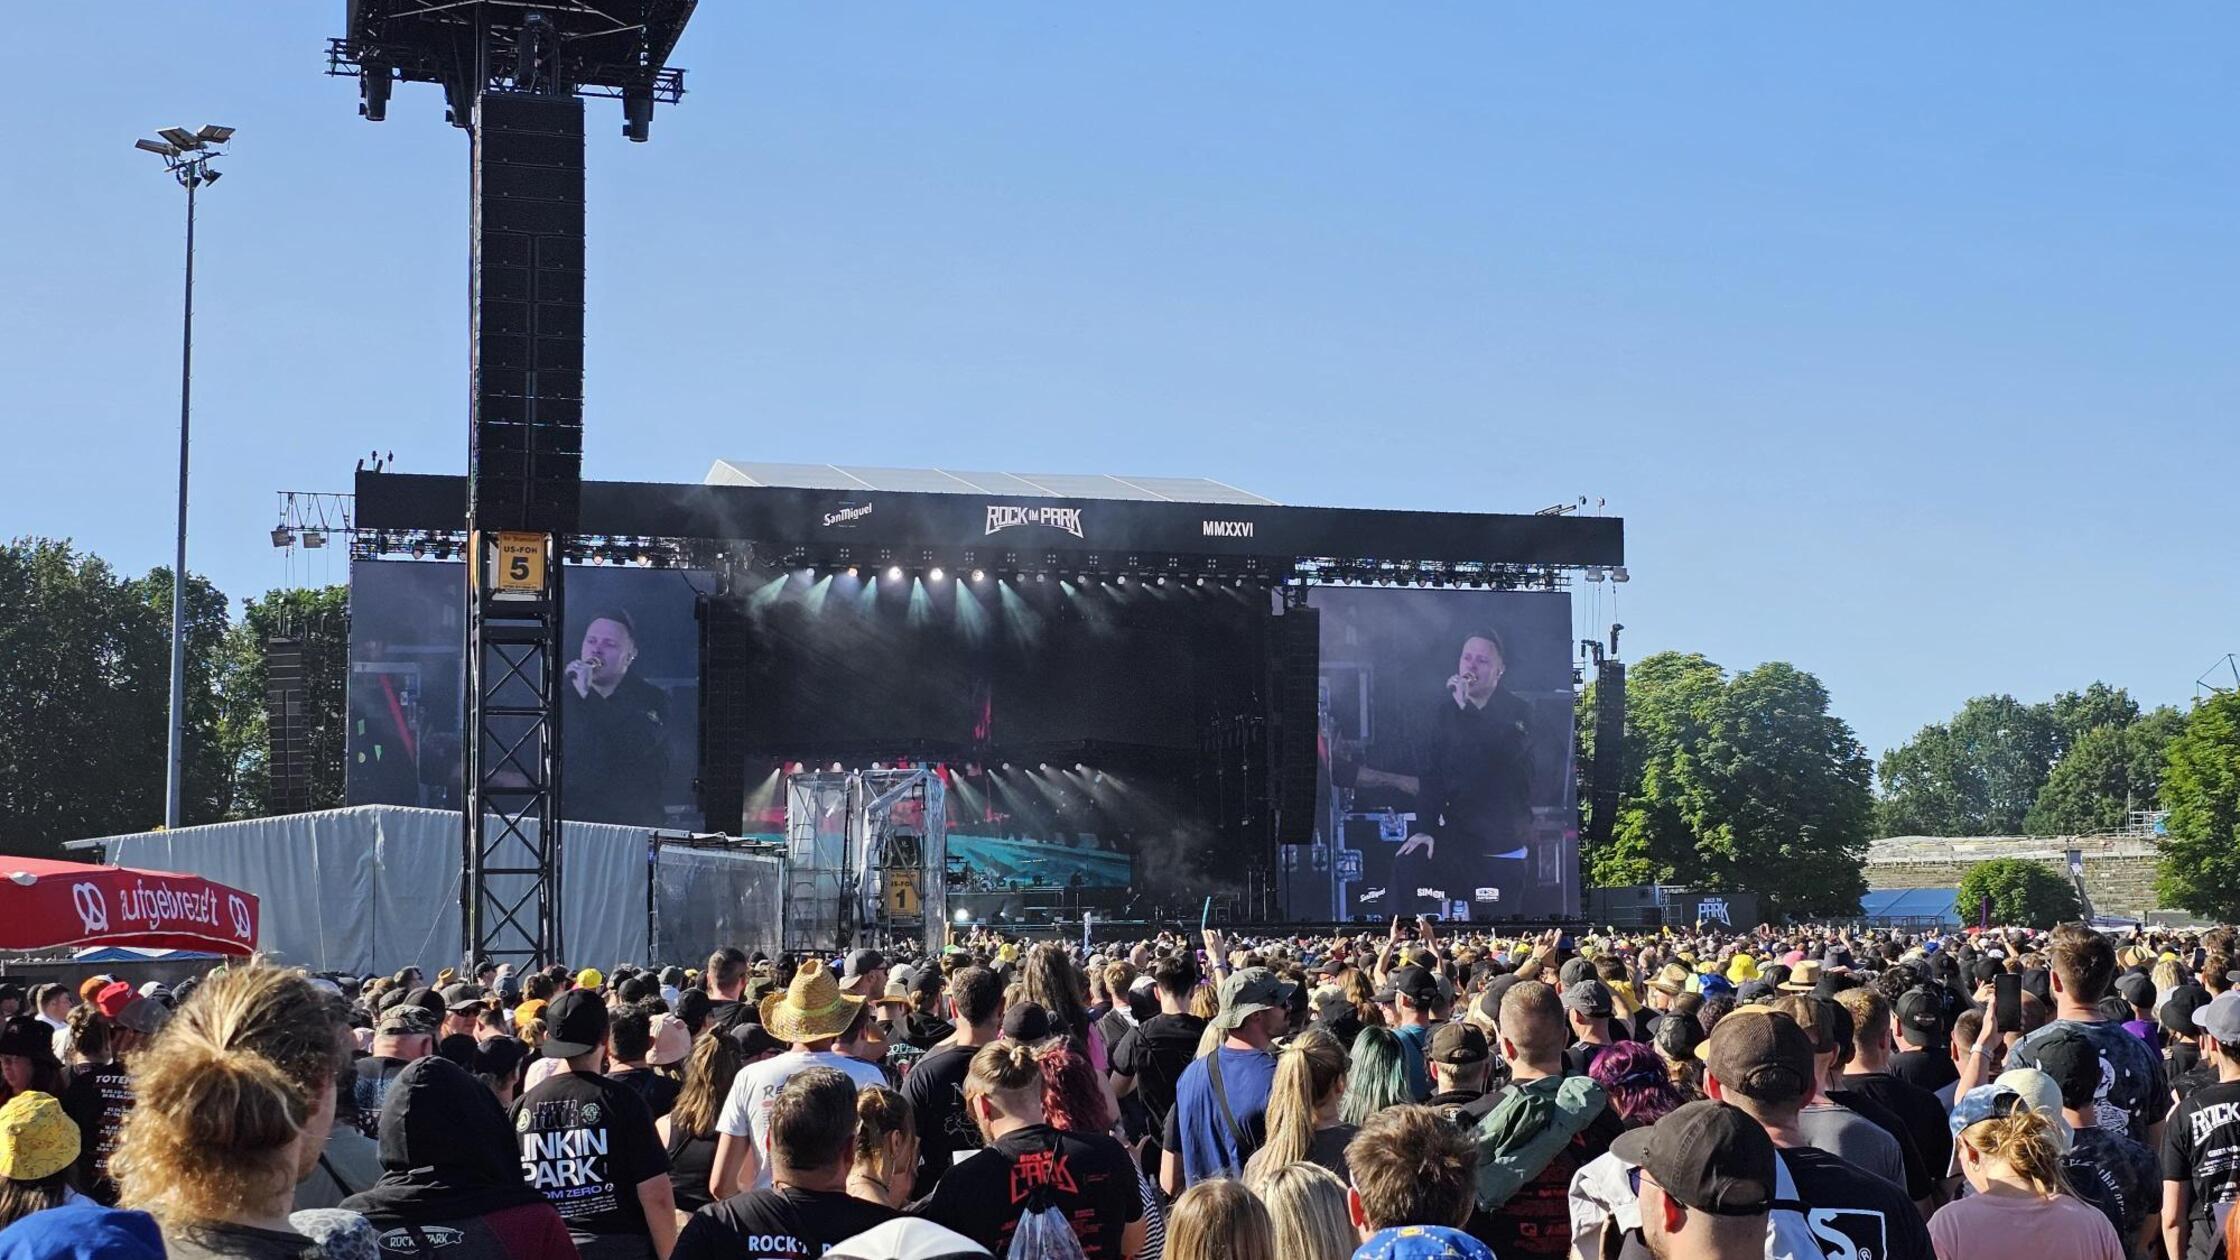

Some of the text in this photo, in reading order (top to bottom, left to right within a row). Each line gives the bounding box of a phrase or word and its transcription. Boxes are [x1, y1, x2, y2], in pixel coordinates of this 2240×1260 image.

[985, 505, 1084, 539] ROCK IM PARK
[1202, 520, 1254, 537] MMXXVI
[503, 546, 538, 554] US-FOH
[510, 556, 529, 581] 5
[896, 889, 905, 908] 1
[1698, 902, 1731, 926] PARK
[2189, 1102, 2240, 1147] ROCK
[566, 1185, 602, 1198] ZERO
[748, 1234, 798, 1253] ROCK
